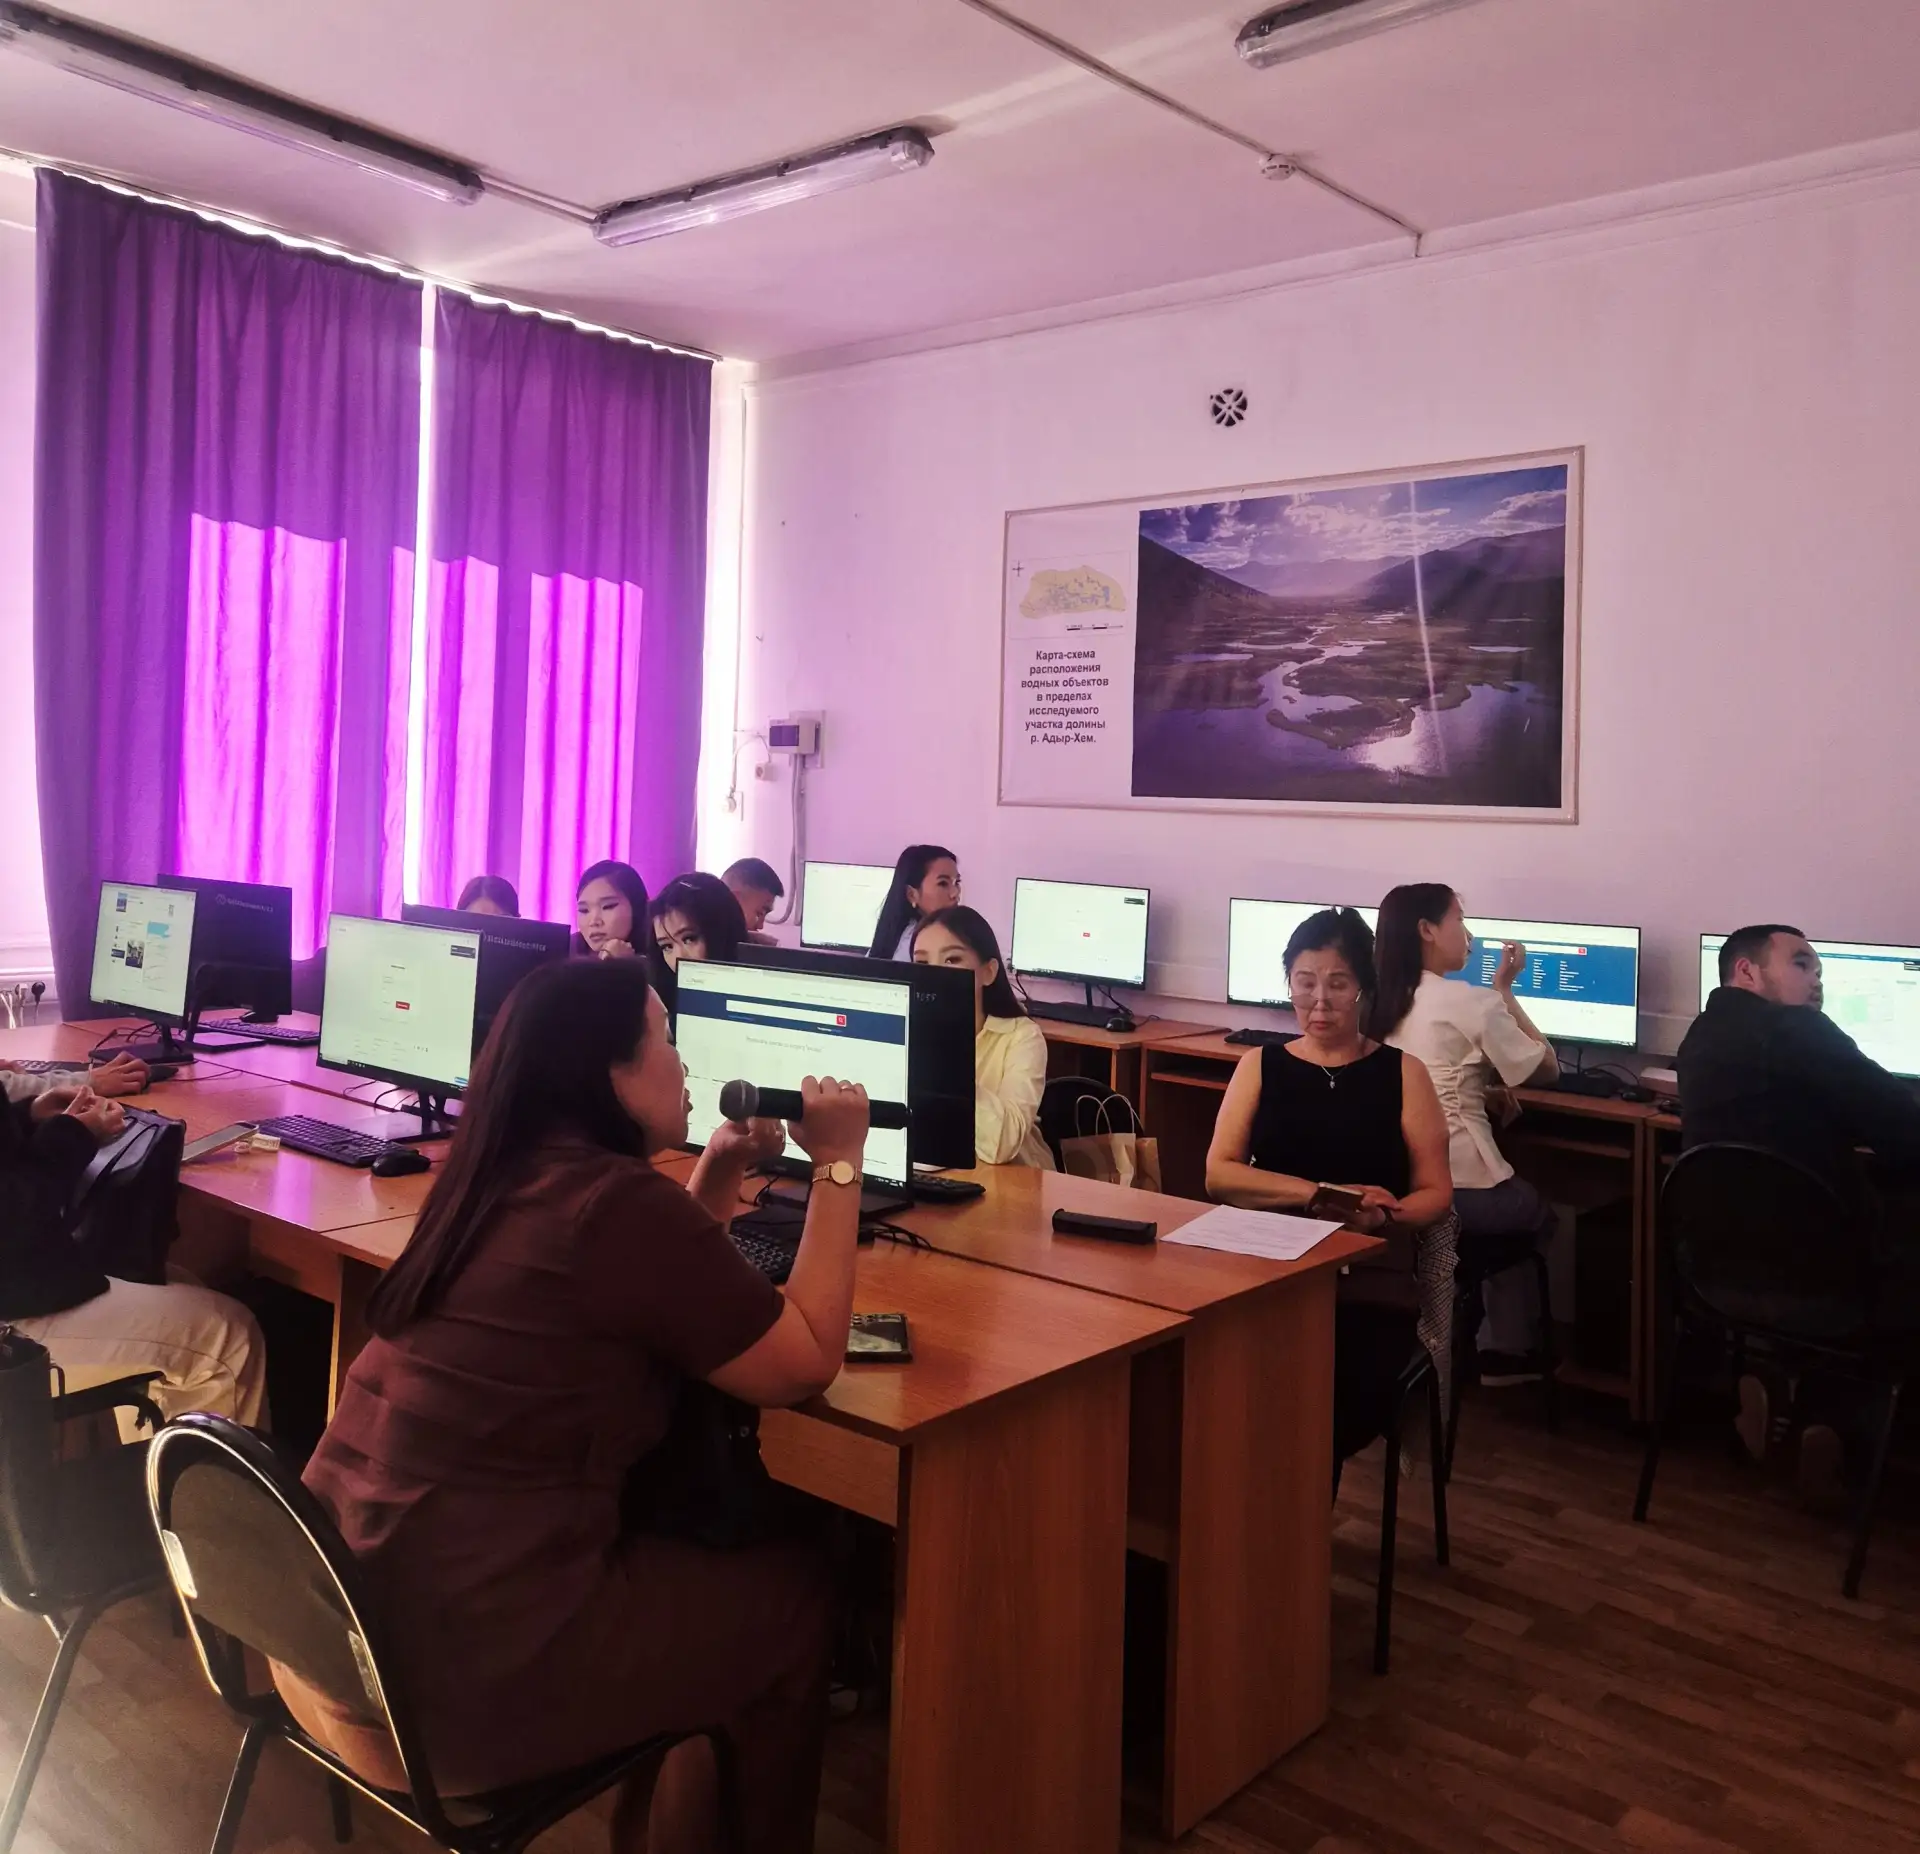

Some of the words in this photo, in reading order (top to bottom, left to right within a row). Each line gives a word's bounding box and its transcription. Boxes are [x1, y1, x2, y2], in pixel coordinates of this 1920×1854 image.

[1036, 650, 1096, 662] Карта-схема
[1029, 664, 1101, 676] расположения
[1021, 679, 1059, 689] водных
[1062, 677, 1109, 688] объектов
[1036, 693, 1043, 701] в
[1045, 692, 1092, 703] пределах
[1029, 706, 1099, 717] исследуемого
[1025, 721, 1063, 731] участка
[1065, 720, 1106, 730] долины
[1030, 734, 1039, 744] р.
[1042, 733, 1097, 745] Адыр-Хем.
